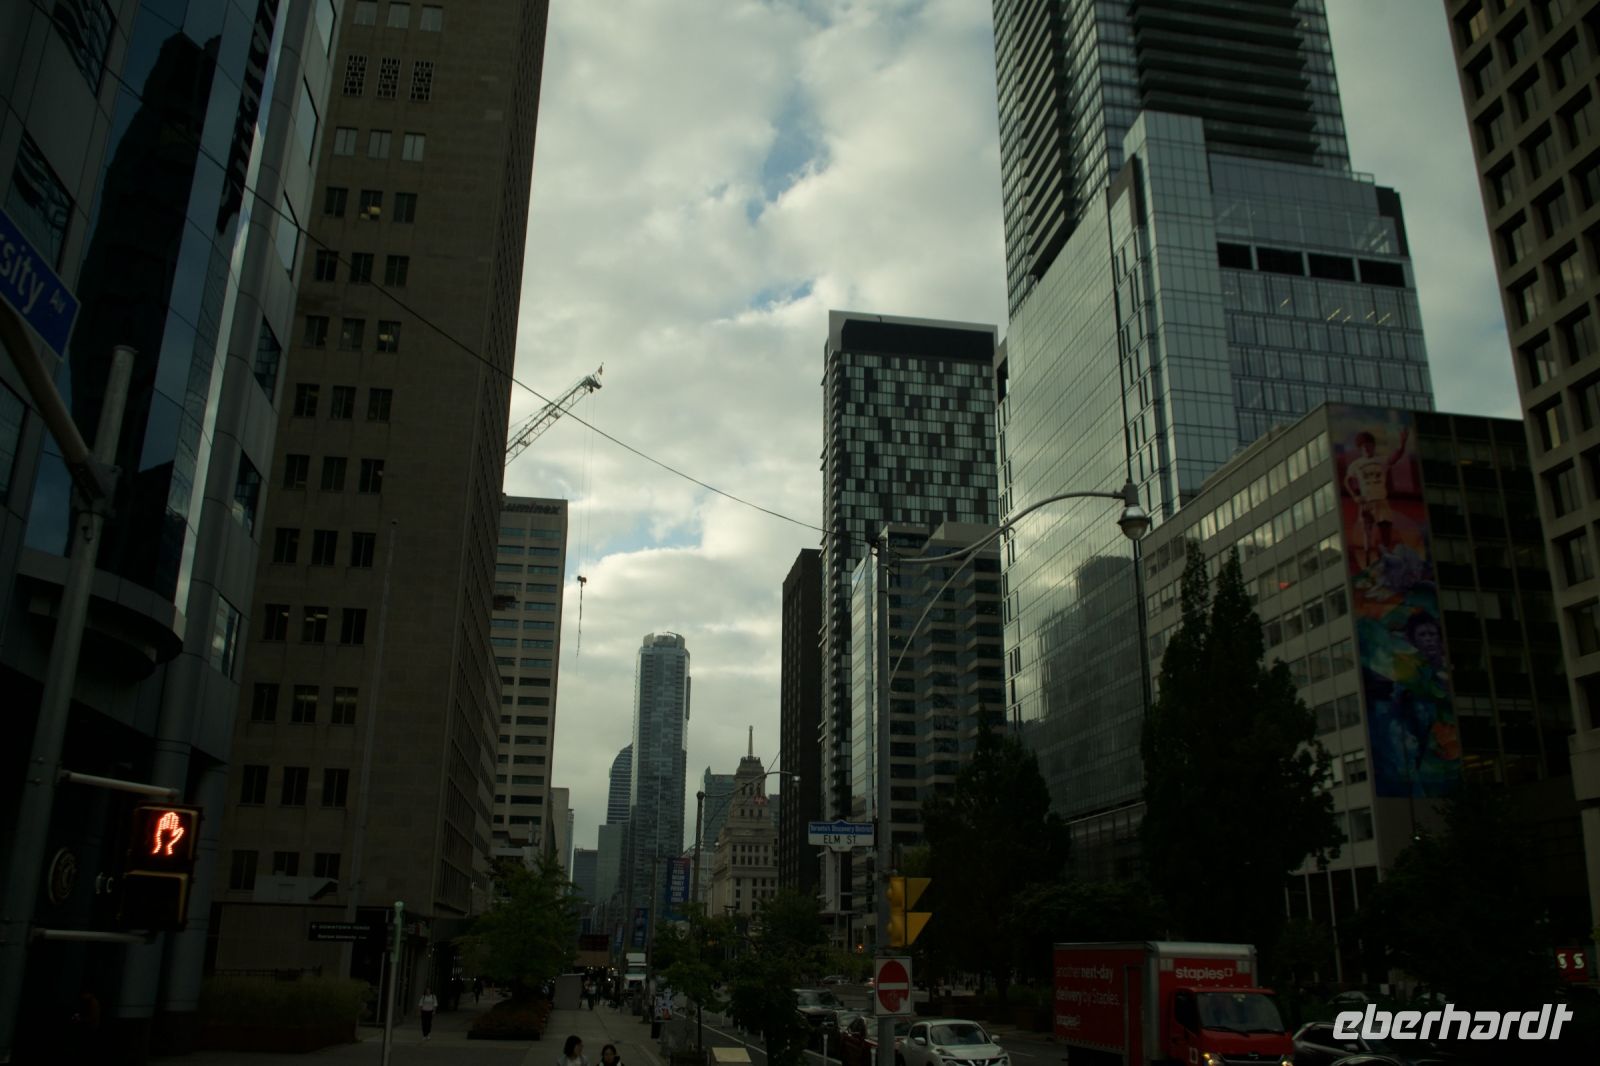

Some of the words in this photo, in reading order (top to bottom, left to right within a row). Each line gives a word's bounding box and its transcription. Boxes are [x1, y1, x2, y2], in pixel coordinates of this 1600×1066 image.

[824, 834, 840, 844] ELM
[847, 835, 857, 845] ST
[1175, 967, 1226, 981] staples
